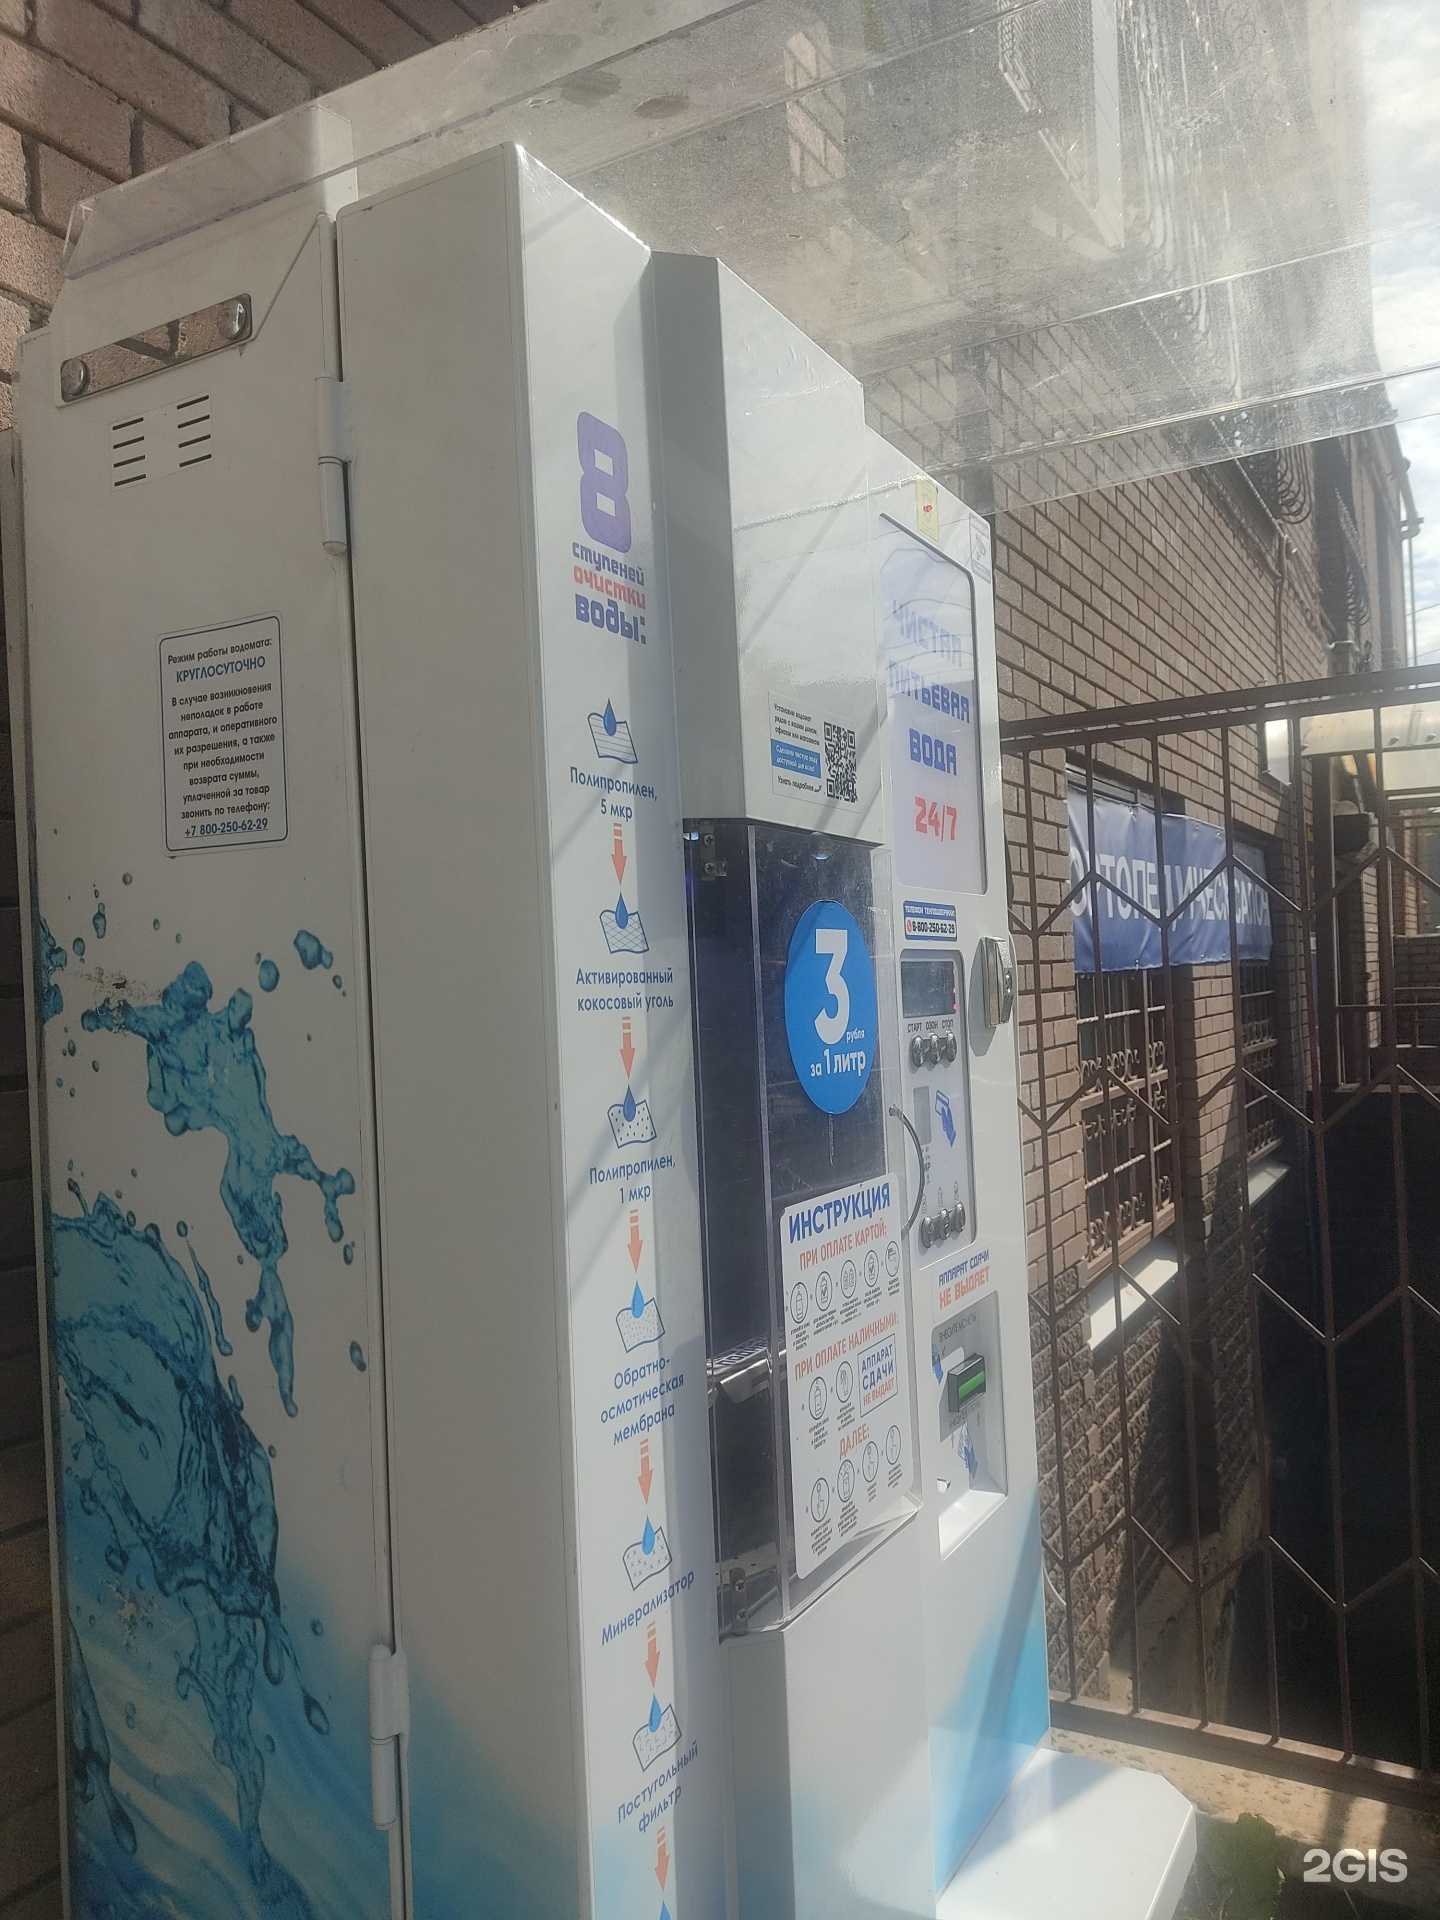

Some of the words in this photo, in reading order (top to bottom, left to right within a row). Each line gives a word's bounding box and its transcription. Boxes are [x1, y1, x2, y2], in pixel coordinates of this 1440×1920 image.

[577, 411, 631, 553] 8
[572, 542, 645, 586] ступеней
[573, 565, 646, 609] очистки
[575, 594, 646, 644] воды:
[167, 652, 195, 665] Режим
[197, 647, 228, 663] работы
[230, 638, 272, 654] водомата:
[176, 655, 266, 683] КРУГЛОСУТОЧНО
[171, 697, 177, 706] В
[179, 693, 208, 707] случае
[210, 682, 272, 701] возникновения
[181, 707, 224, 722] неполадок
[233, 701, 264, 716] работе
[168, 725, 211, 740] аппарата,
[220, 715, 278, 733] оперативного
[174, 746, 184, 756] их
[186, 739, 240, 757] разрешения,
[250, 732, 276, 745] также
[909, 728, 957, 776] ВОДА
[183, 760, 199, 772] при
[201, 751, 265, 769] необходимости
[182, 787, 231, 805] уплаченной
[232, 787, 244, 796] за
[245, 783, 270, 797] товар
[189, 774, 228, 787] возврата
[569, 766, 658, 801] Полипропилен,
[181, 808, 212, 820] звонить
[214, 807, 225, 816] по
[226, 800, 271, 817] телефону:
[600, 798, 607, 815] 5
[610, 802, 633, 822] мкр
[914, 796, 958, 842] 24/7
[185, 824, 197, 837] +7
[199, 817, 269, 836] 800-250-62-29
[575, 967, 674, 992] Активированный
[814, 928, 850, 1045] 3
[577, 992, 643, 1012] кокосовый
[646, 992, 674, 1013] уголь
[846, 1027, 865, 1044] рубля
[810, 1062, 822, 1077] за
[823, 1048, 831, 1075] 1
[833, 1049, 866, 1076] литр
[589, 1154, 676, 1185] Полипропилен,
[619, 1187, 624, 1204] 1
[628, 1183, 651, 1202] мкр
[788, 1182, 891, 1243] ИНСТРУКЦИЯ
[799, 1249, 818, 1271] ПРИ
[820, 1234, 853, 1262] ОПЛАТЕ
[854, 1220, 887, 1249] КАРТОЙ:
[938, 1259, 968, 1287] АППАРАТ
[939, 1289, 952, 1311] НЕ
[954, 1266, 990, 1302] ВЫДАЕТ
[613, 1357, 671, 1390] Обратно-
[794, 1359, 813, 1383] ПРИ
[815, 1341, 847, 1369] ОПЛАТЕ
[861, 1343, 893, 1374] АППАРАТ
[862, 1361, 895, 1391] СДАЧИ
[863, 1391, 872, 1406] НЕ
[872, 1376, 895, 1402] ВЫДАЕТ
[600, 1372, 685, 1424] осмотическая
[613, 1402, 675, 1446] мембрана
[839, 1423, 870, 1457] ДАЛЕЕ:
[600, 1569, 696, 1647] Минерализатор
[616, 1742, 699, 1825] Постугольный
[638, 1784, 682, 1833] фильтр
